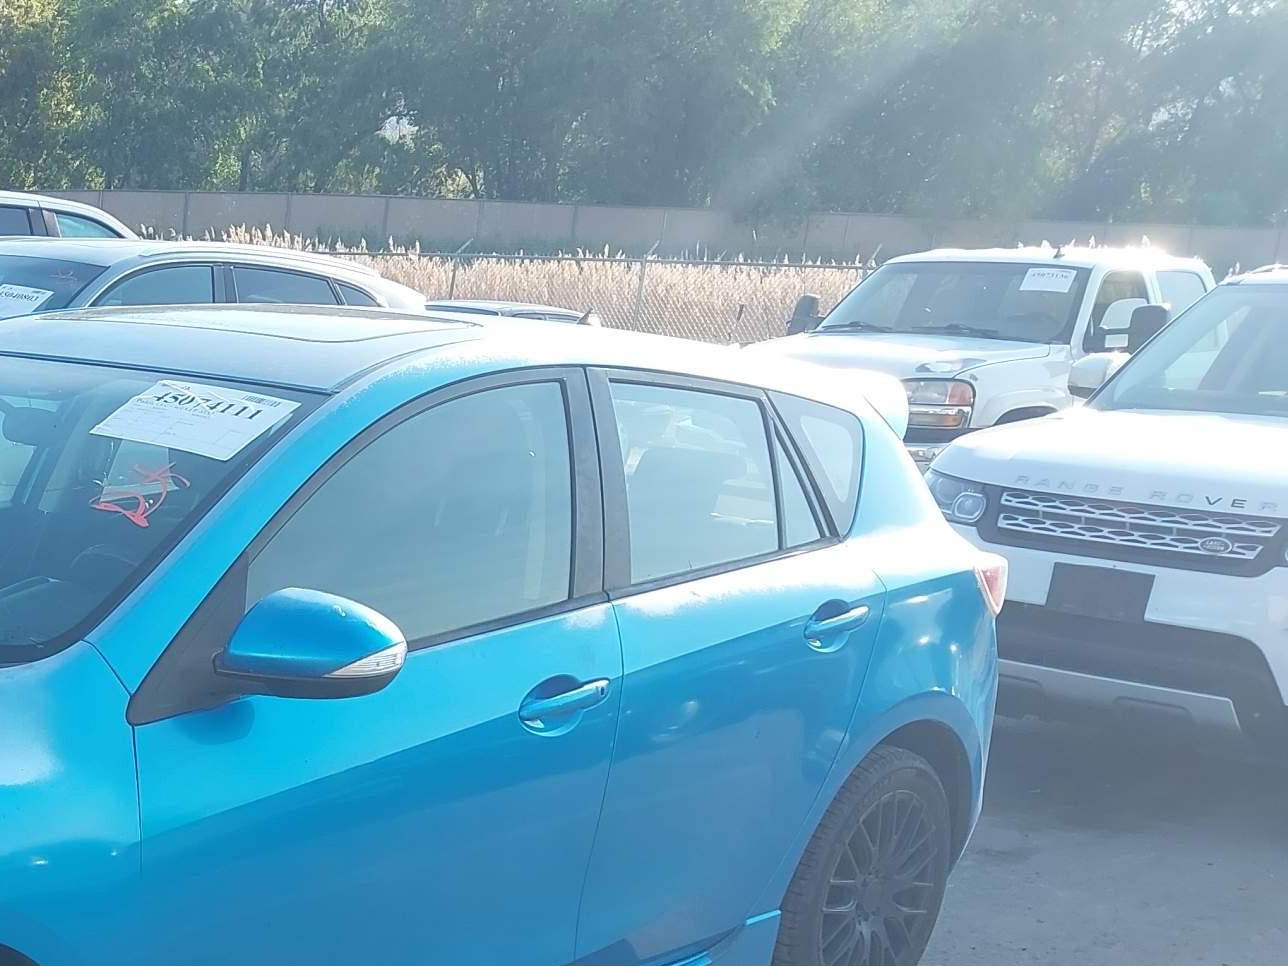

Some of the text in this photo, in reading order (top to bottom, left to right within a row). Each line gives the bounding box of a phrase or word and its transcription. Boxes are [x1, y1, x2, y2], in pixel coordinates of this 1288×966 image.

[153, 390, 264, 420] 45074111
[1012, 475, 1280, 512] RANGE ROVER
